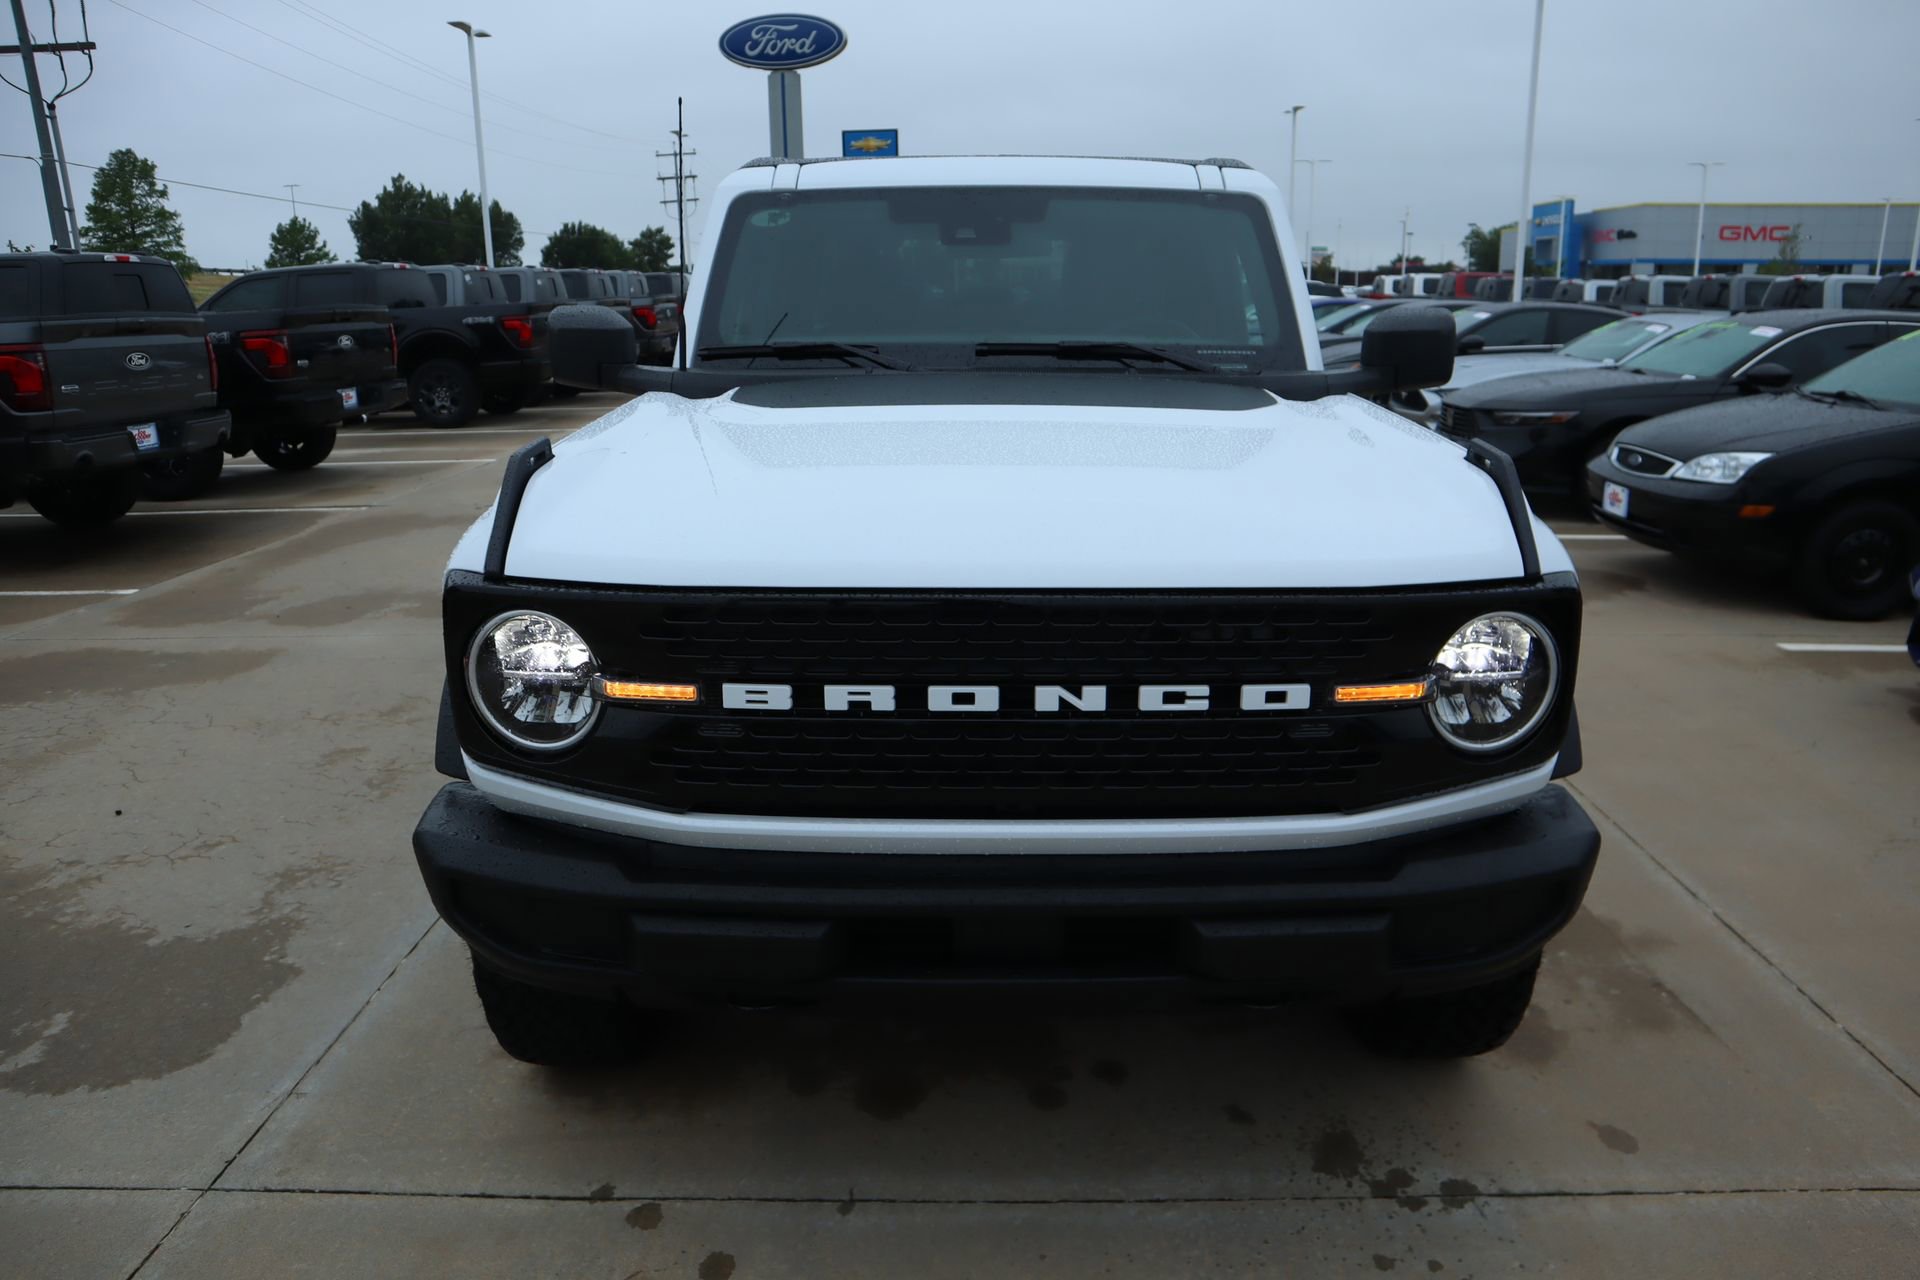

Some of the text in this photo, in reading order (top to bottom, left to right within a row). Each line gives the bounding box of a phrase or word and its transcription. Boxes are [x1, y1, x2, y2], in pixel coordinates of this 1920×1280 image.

[746, 24, 817, 56] Ford
[1719, 225, 1791, 241] GMC
[722, 682, 1312, 711] BRONCO
